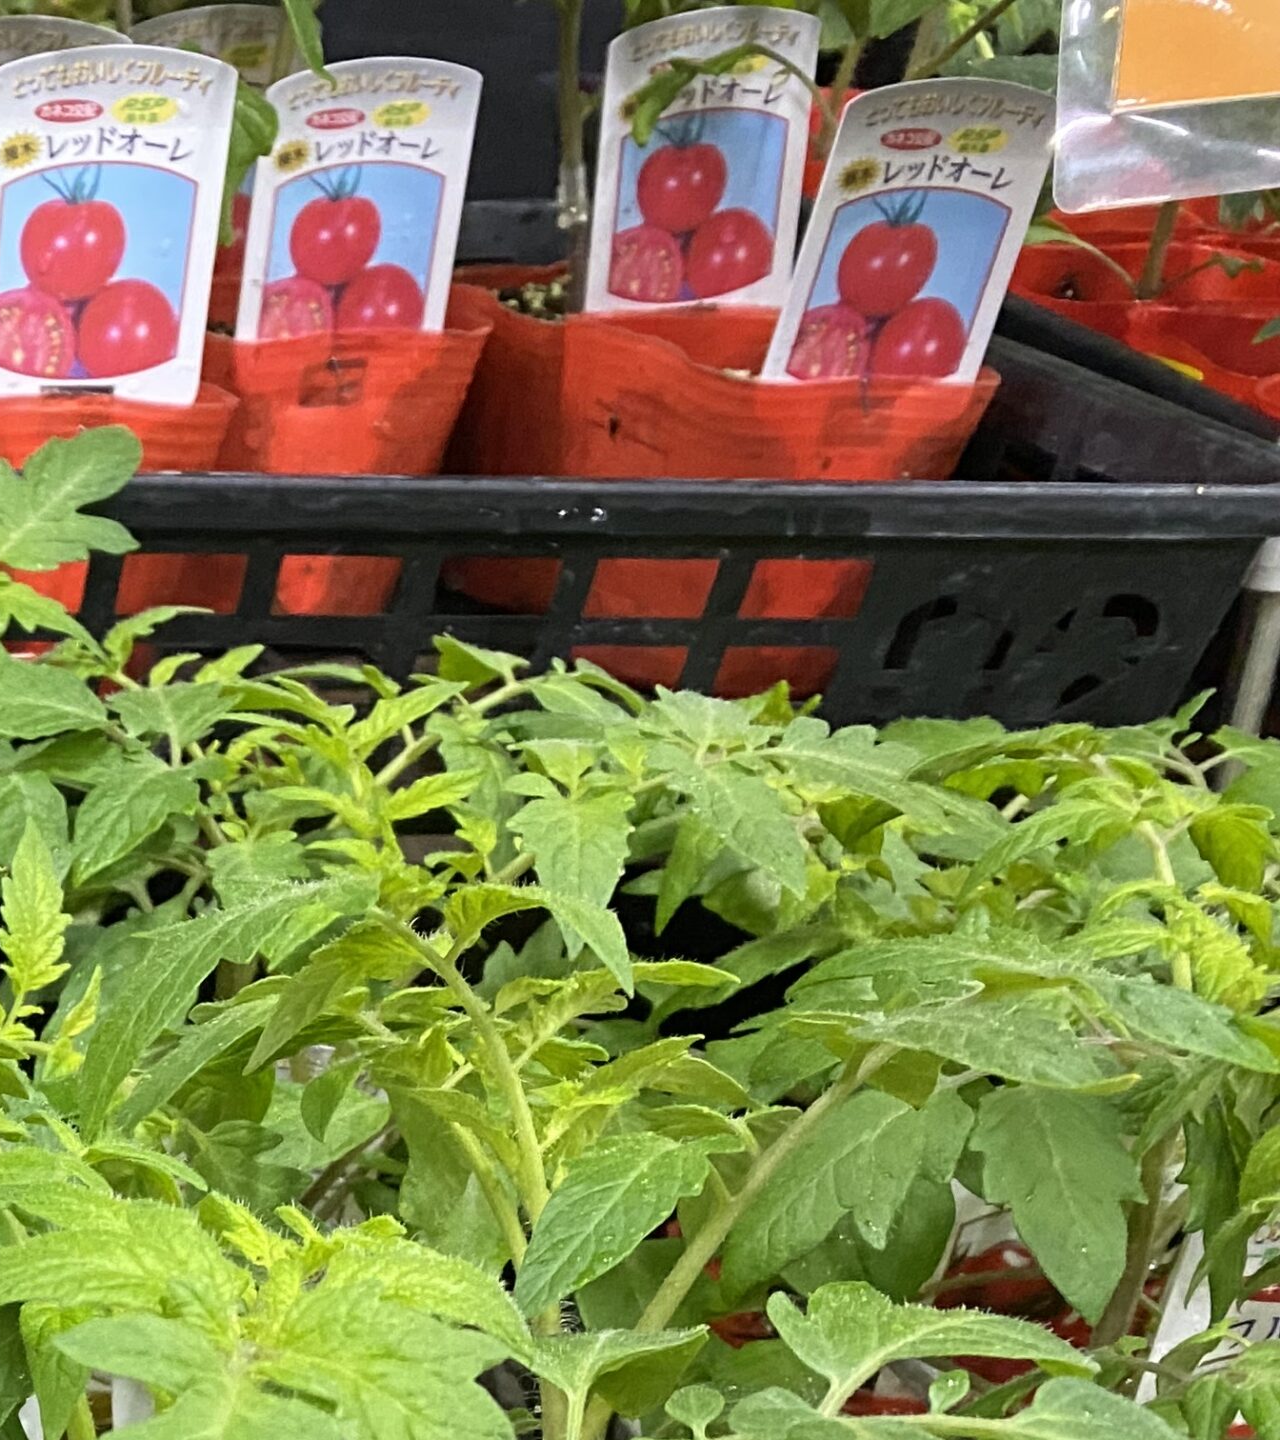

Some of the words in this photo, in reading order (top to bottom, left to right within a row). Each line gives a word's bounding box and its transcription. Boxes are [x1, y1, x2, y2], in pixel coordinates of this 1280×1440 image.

[46, 127, 194, 162] レッドオーレ
[315, 131, 441, 162] レッドオーレ
[883, 155, 1013, 190] レッドオーレ
